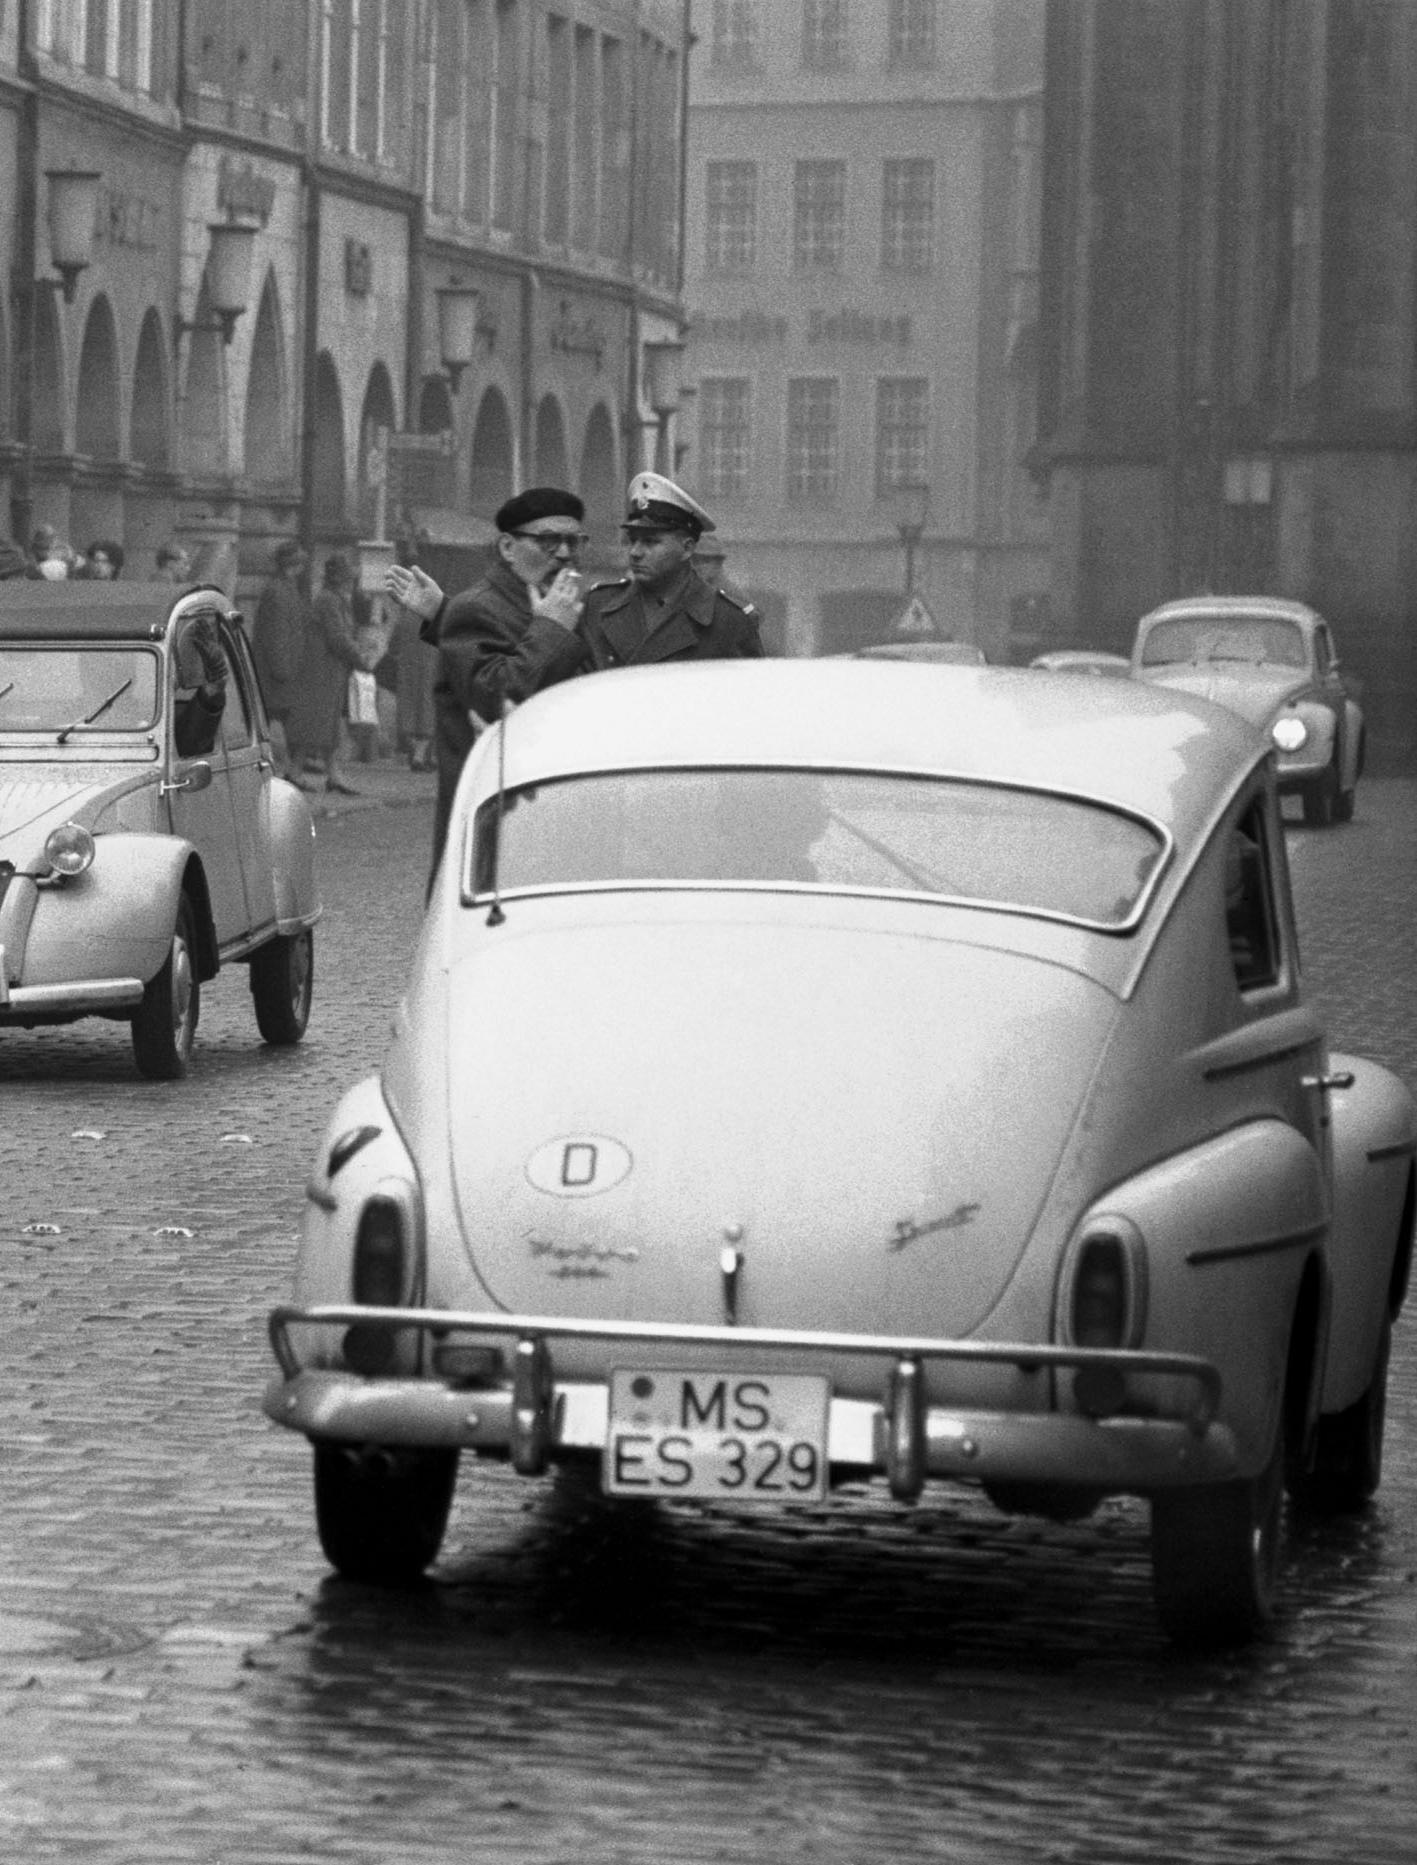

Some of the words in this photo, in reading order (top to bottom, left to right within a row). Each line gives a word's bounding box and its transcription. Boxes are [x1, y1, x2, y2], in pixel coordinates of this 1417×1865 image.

[561, 1142, 598, 1187] D
[682, 1379, 771, 1432] MS
[615, 1434, 693, 1486] ES
[718, 1438, 817, 1491] 329
